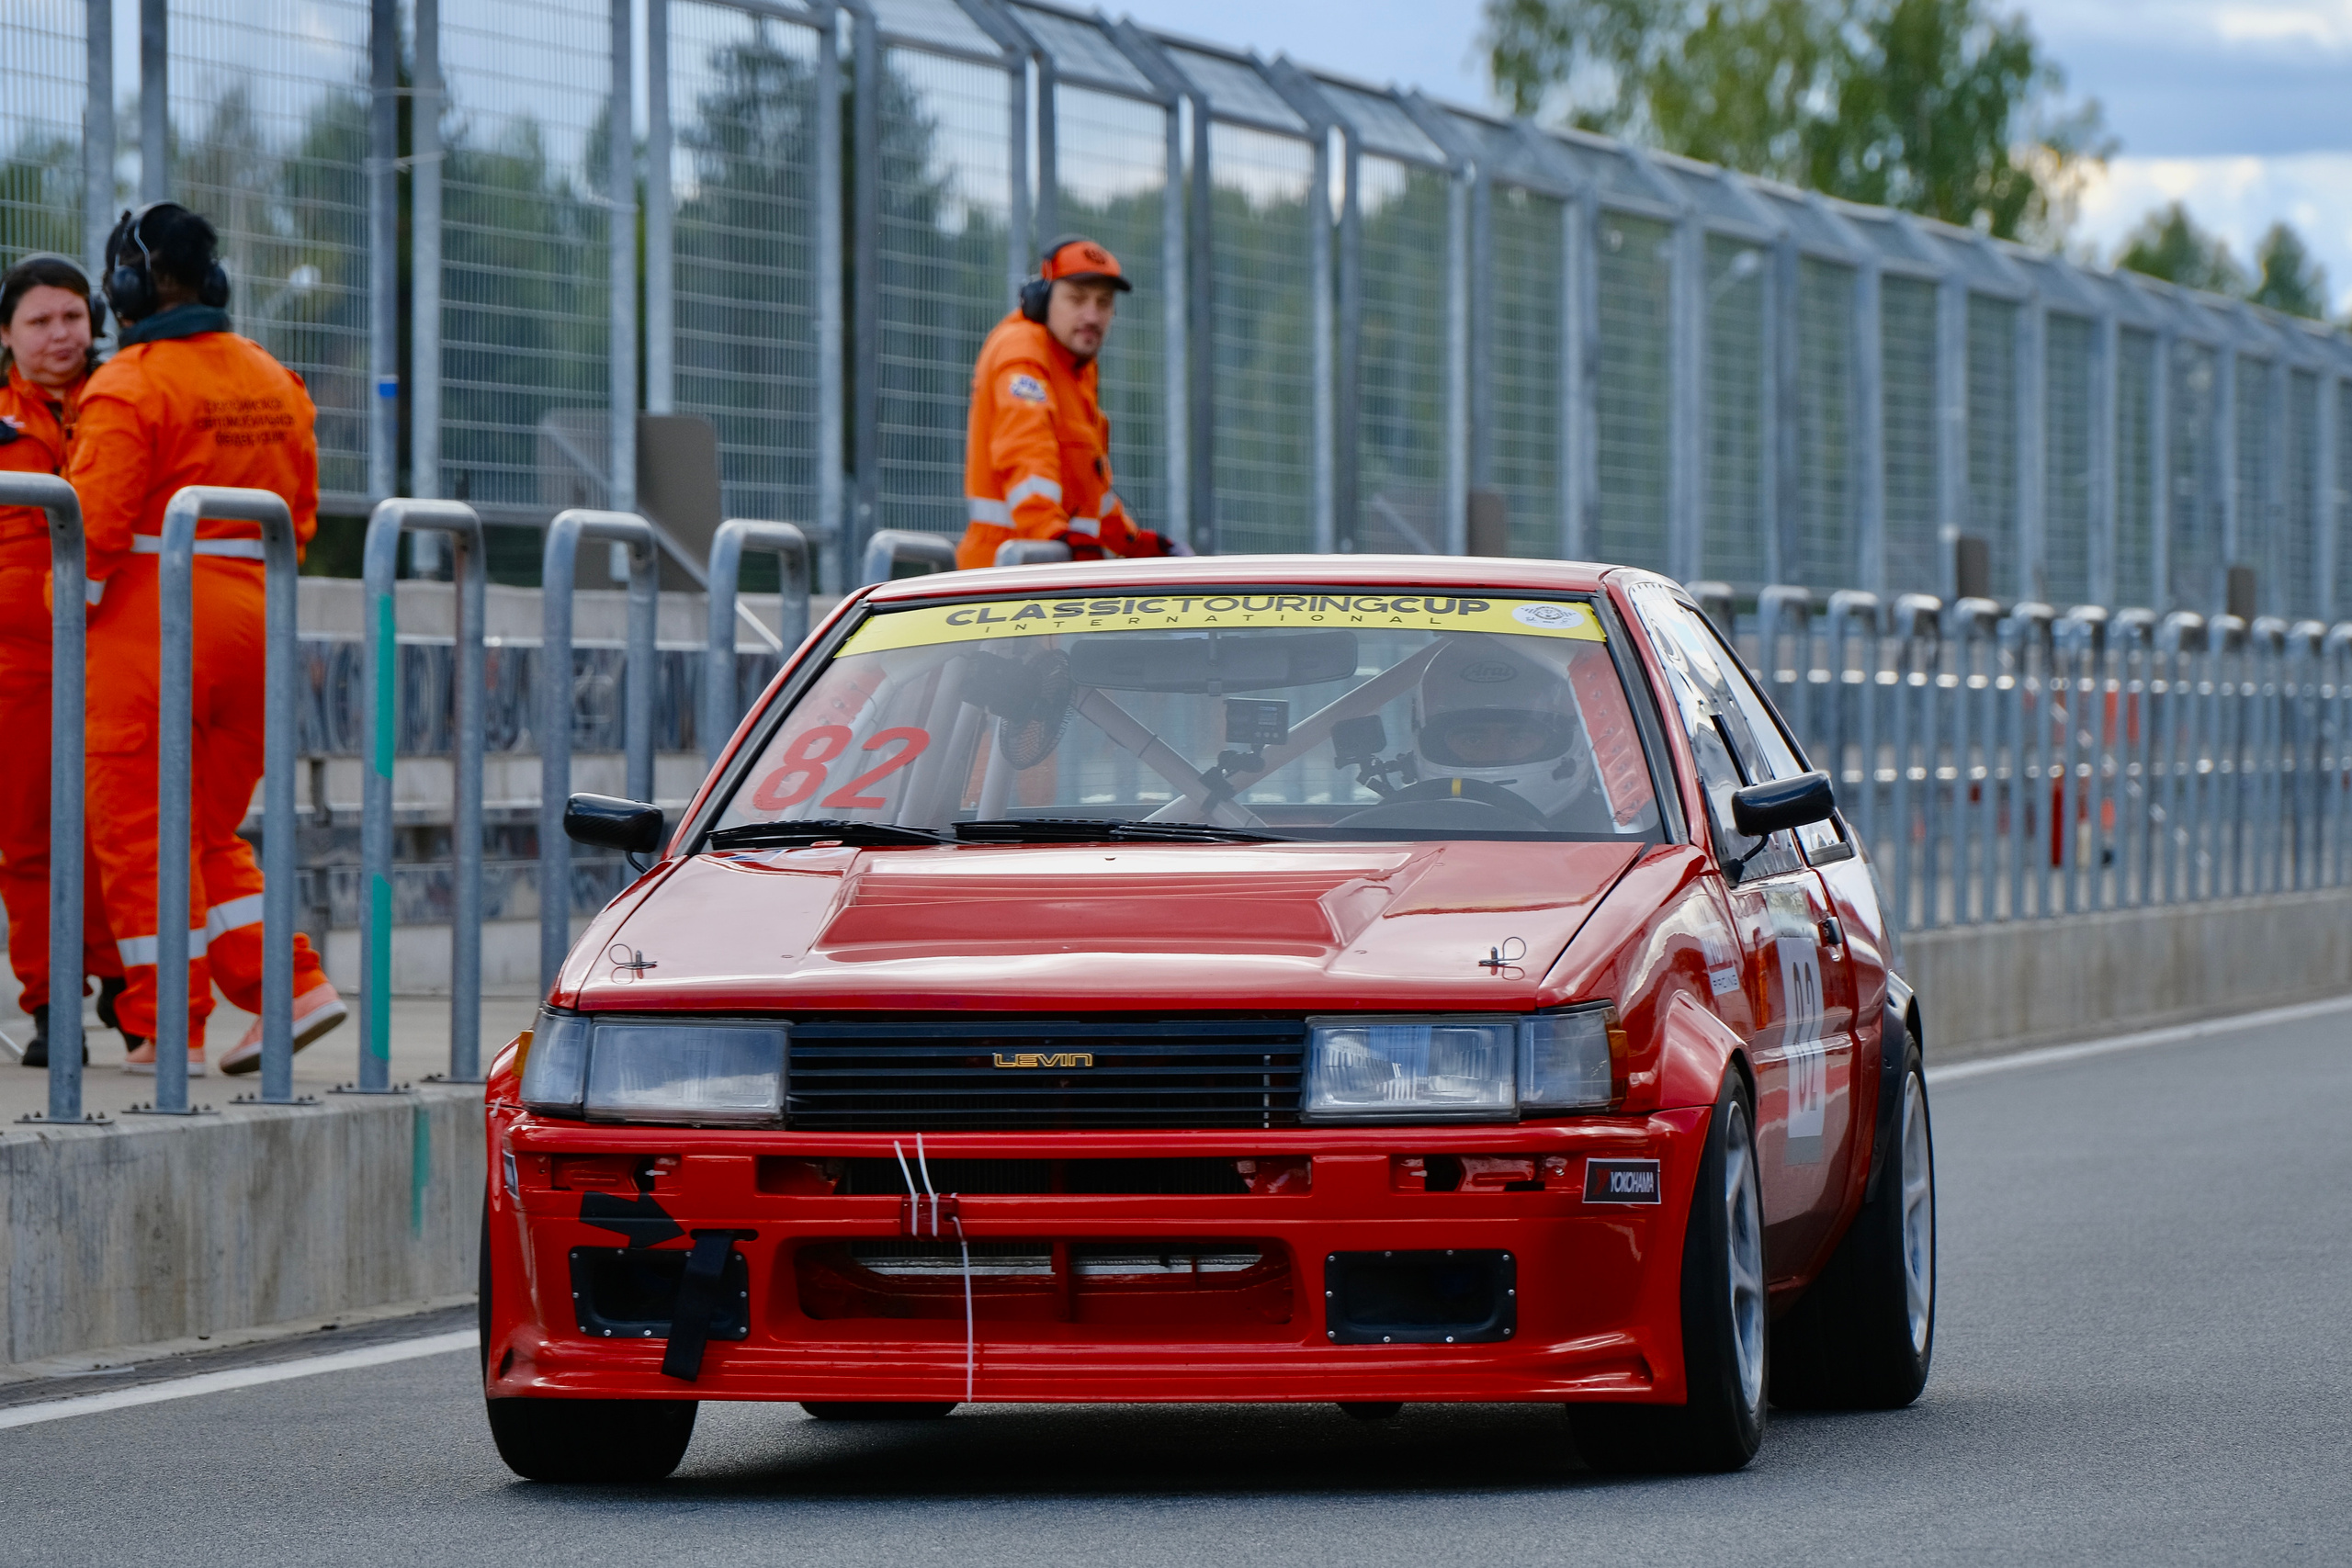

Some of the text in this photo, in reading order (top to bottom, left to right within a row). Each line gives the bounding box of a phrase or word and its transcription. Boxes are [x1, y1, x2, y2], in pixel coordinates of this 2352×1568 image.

[985, 615, 1442, 633] INTERNATIONAL
[752, 725, 931, 811] 82
[993, 1053, 1093, 1067] LEVIN
[1610, 1171, 1655, 1193] YOKOHAMA
